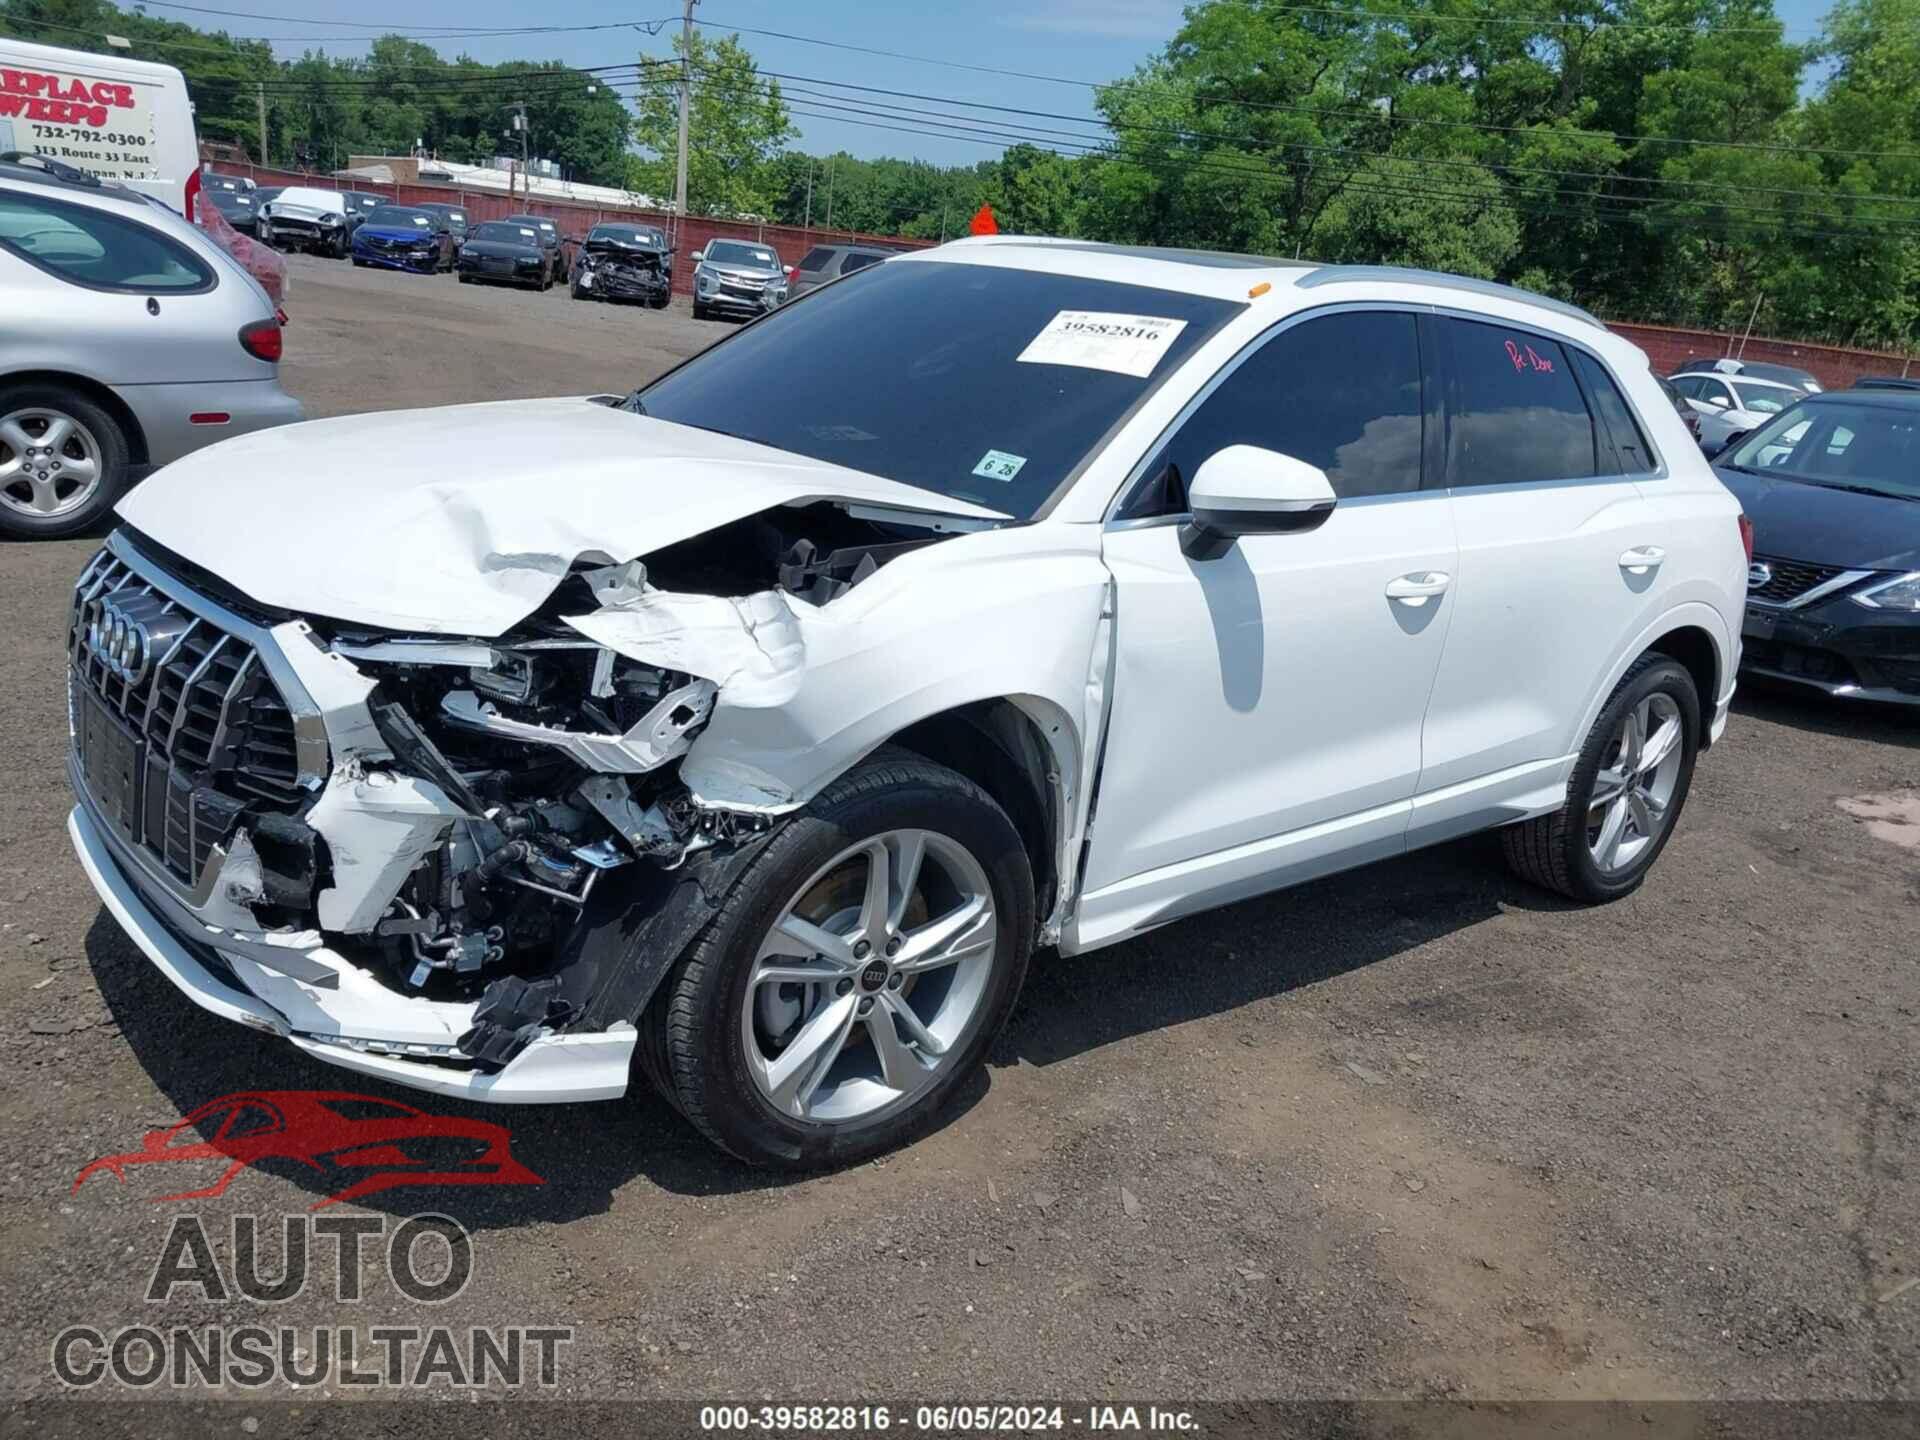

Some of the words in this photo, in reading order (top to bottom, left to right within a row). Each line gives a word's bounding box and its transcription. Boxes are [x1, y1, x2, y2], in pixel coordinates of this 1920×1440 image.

[0, 69, 135, 108] EPLACE
[33, 125, 146, 146] 732-792-0300
[34, 145, 58, 157] 313
[61, 146, 101, 161] Route
[105, 151, 120, 162] 33
[123, 153, 151, 165] East
